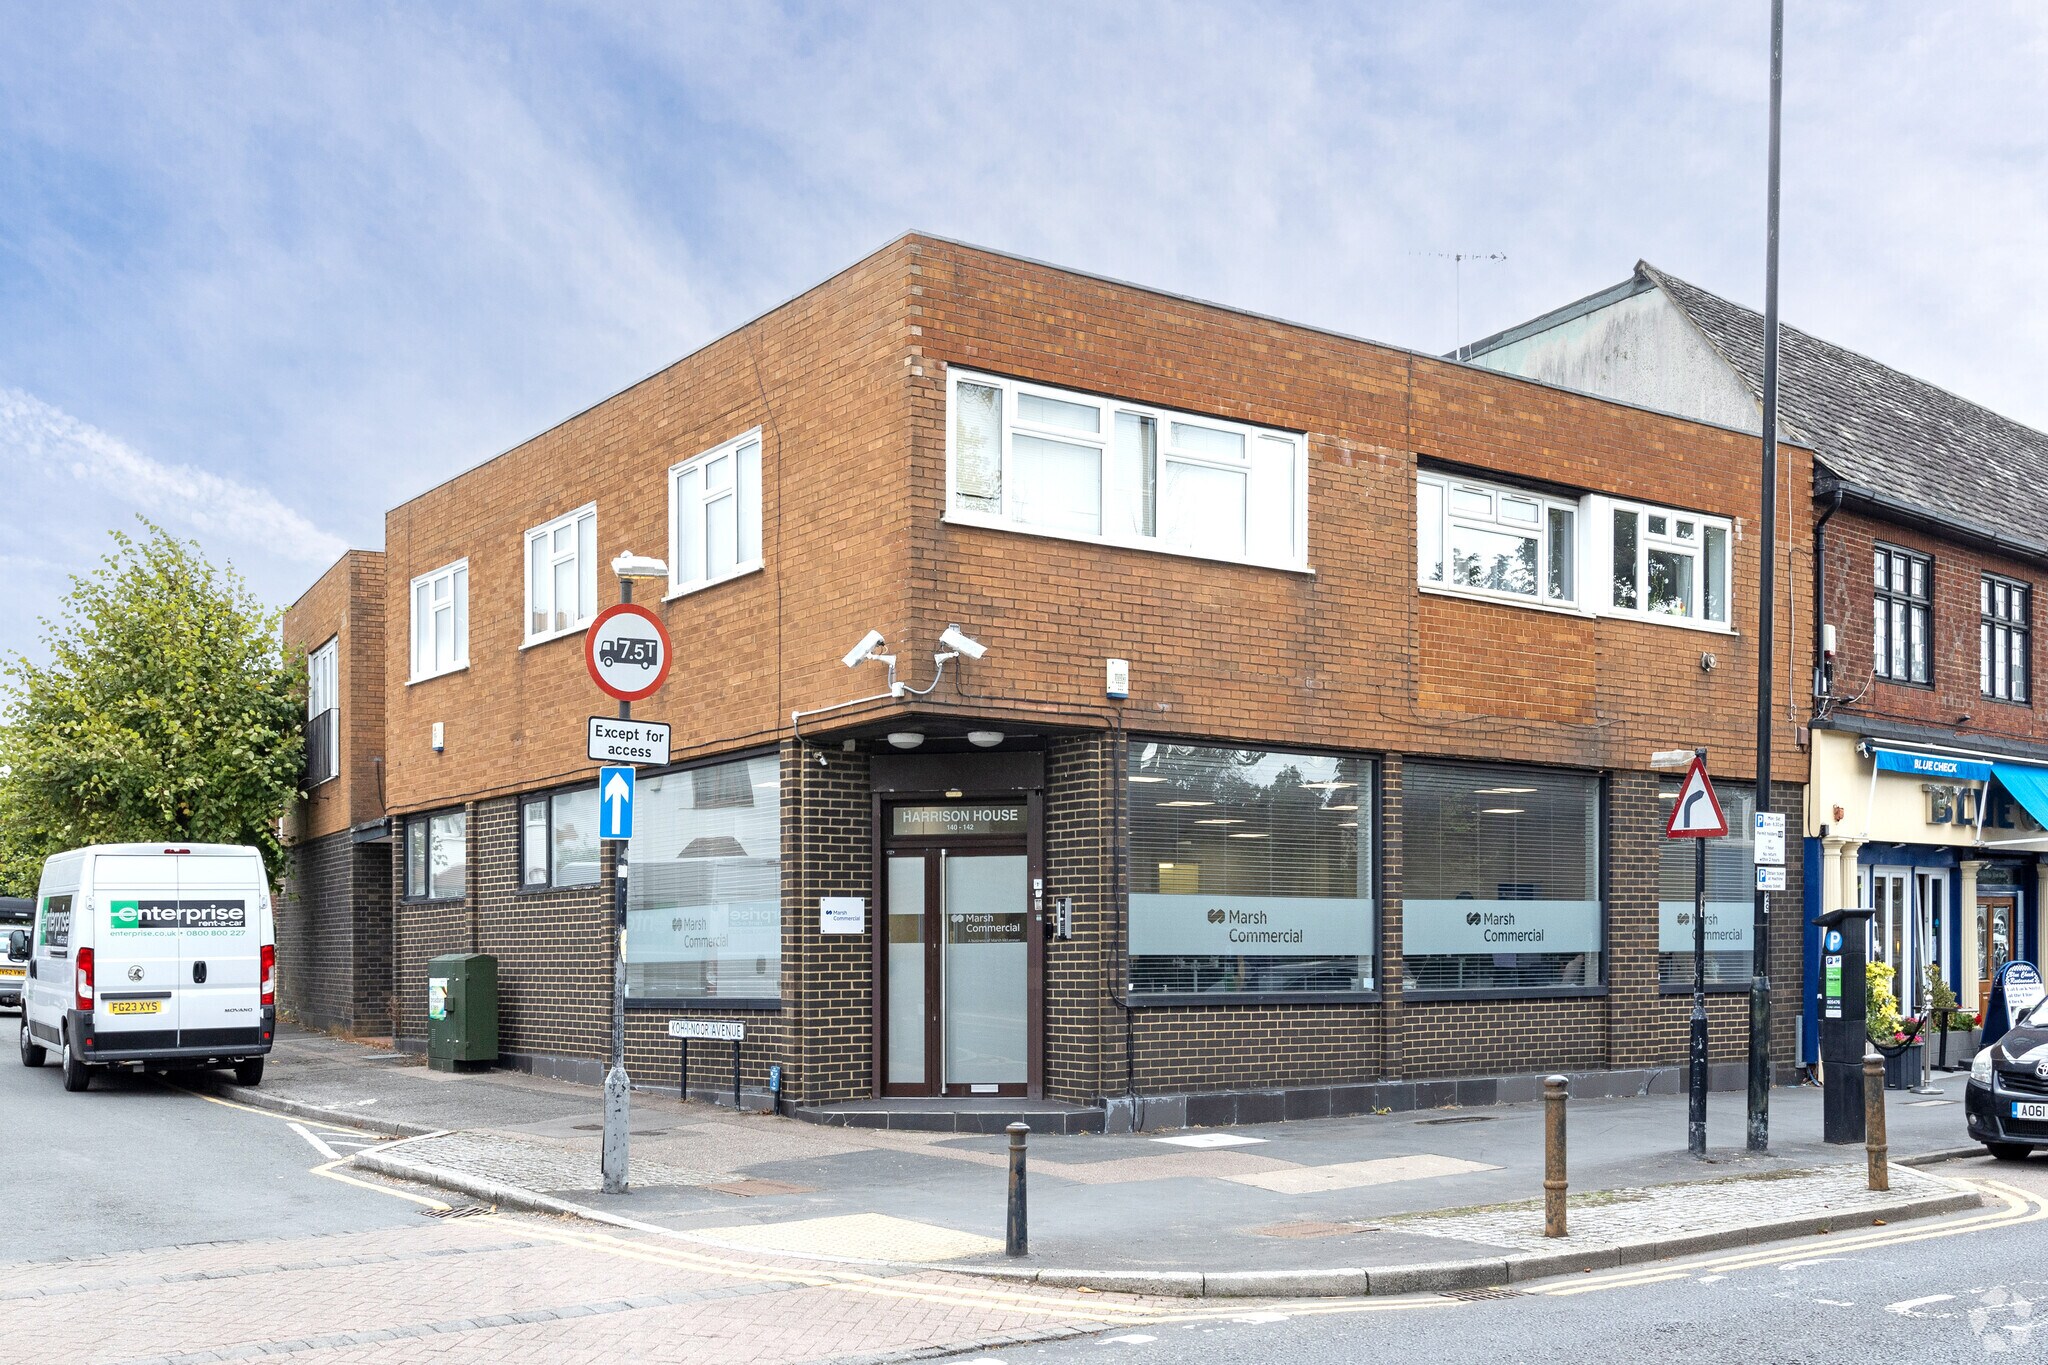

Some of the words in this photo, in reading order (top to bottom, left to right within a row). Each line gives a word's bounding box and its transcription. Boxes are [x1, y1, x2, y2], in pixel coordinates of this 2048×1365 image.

[619, 640, 656, 660] 7.5T
[595, 725, 640, 742] Except
[646, 729, 664, 743] for
[608, 745, 652, 758] access
[1914, 759, 1933, 771] BLUE
[1934, 761, 1957, 773] CHECK
[903, 810, 970, 823] HARRISON
[973, 809, 1018, 822] HOUSE
[116, 904, 244, 924] enterprise
[966, 914, 994, 923] Marsh
[1229, 909, 1267, 925] Marsh
[1484, 912, 1515, 925] Marsh
[1691, 913, 1718, 925] rsh
[684, 918, 707, 931] Marsh
[966, 923, 1020, 933] Commercial
[110, 929, 176, 938] enterprise.co.uk
[186, 929, 209, 937] 0800
[211, 929, 228, 937] 800
[230, 929, 246, 937] 227
[1229, 928, 1303, 943] Commercial
[1484, 928, 1544, 942] Commercial
[1692, 928, 1743, 940] Cmmercial
[684, 934, 728, 948] Commercial
[1830, 931, 1841, 951] P
[112, 1003, 137, 1012] FG23
[140, 1002, 158, 1011] XYS
[671, 1021, 709, 1035] KOH-I-NOOR
[711, 1024, 741, 1038] AVENUE
